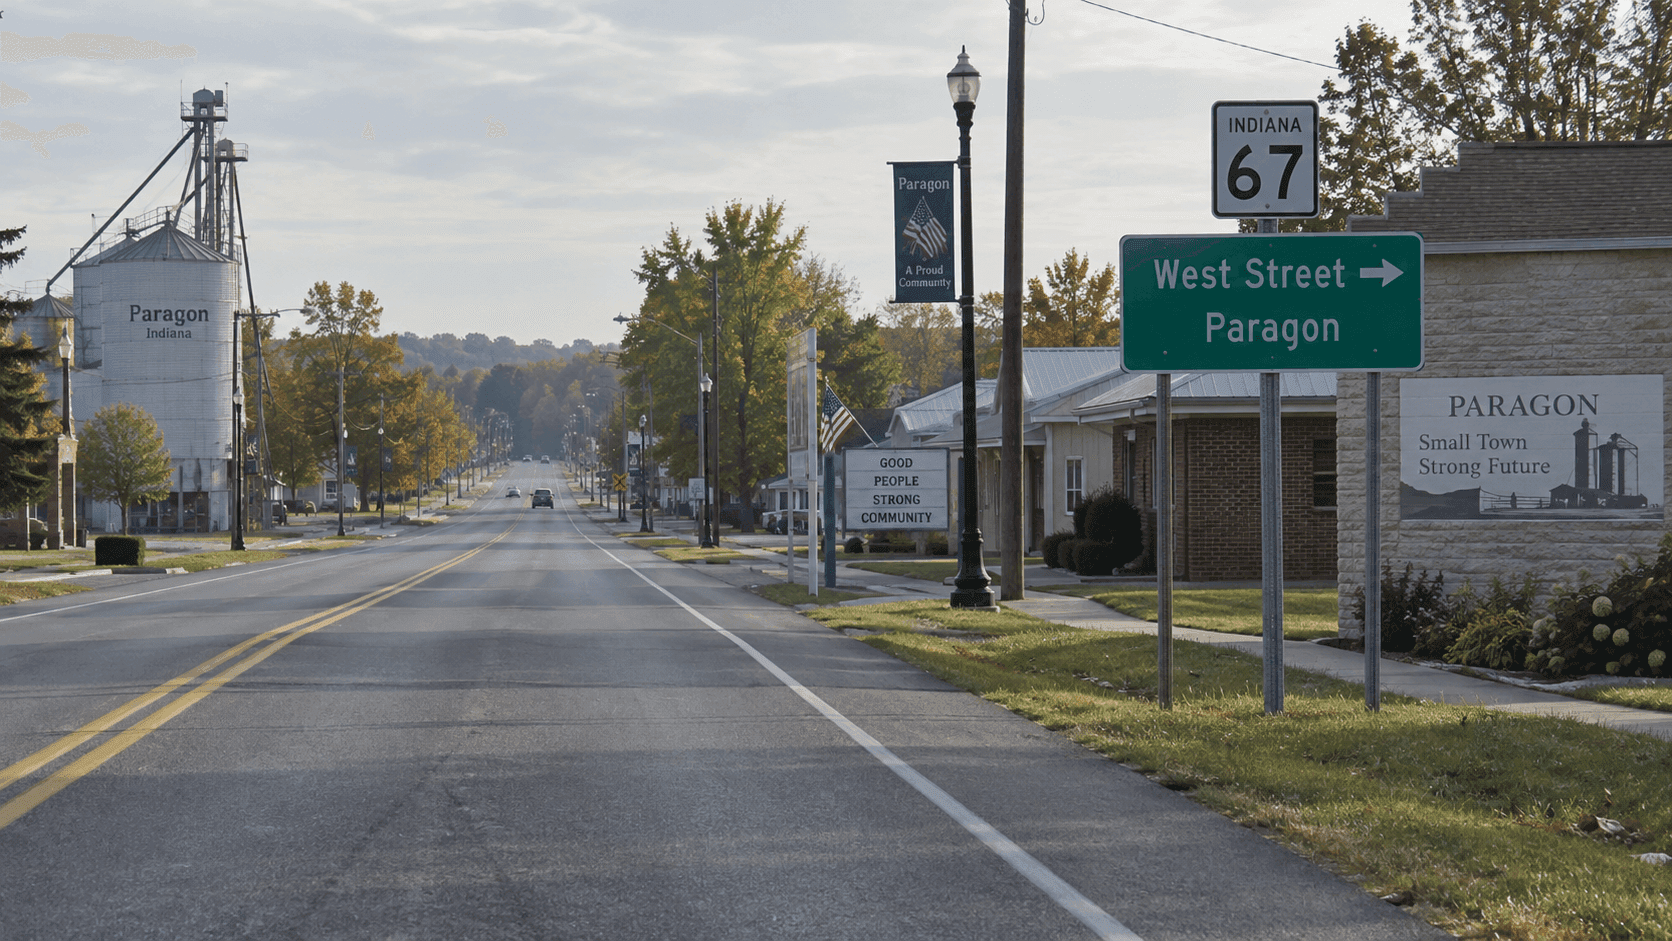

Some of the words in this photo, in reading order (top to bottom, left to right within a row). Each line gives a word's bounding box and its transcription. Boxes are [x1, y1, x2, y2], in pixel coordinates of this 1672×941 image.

[1228, 117, 1302, 133] INDIANA
[1227, 144, 1303, 200] 67
[898, 177, 950, 193] Paragon
[905, 265, 913, 275] A
[915, 265, 944, 275] Proud
[1154, 258, 1231, 290] West
[1245, 257, 1345, 289] Street
[899, 277, 951, 290] Community
[129, 304, 209, 326] Paragon
[146, 327, 192, 339] Indiana
[1206, 312, 1340, 351] Paragon
[1448, 393, 1599, 417] PARAGON
[1419, 433, 1470, 451] Small
[1476, 433, 1528, 450] Town
[880, 457, 913, 468] GOOD
[1419, 457, 1481, 479] Strong
[1487, 457, 1551, 475] Future
[874, 476, 919, 487] PEOPLE
[873, 494, 921, 505] STRONG
[861, 512, 932, 524] COMMUNITY
